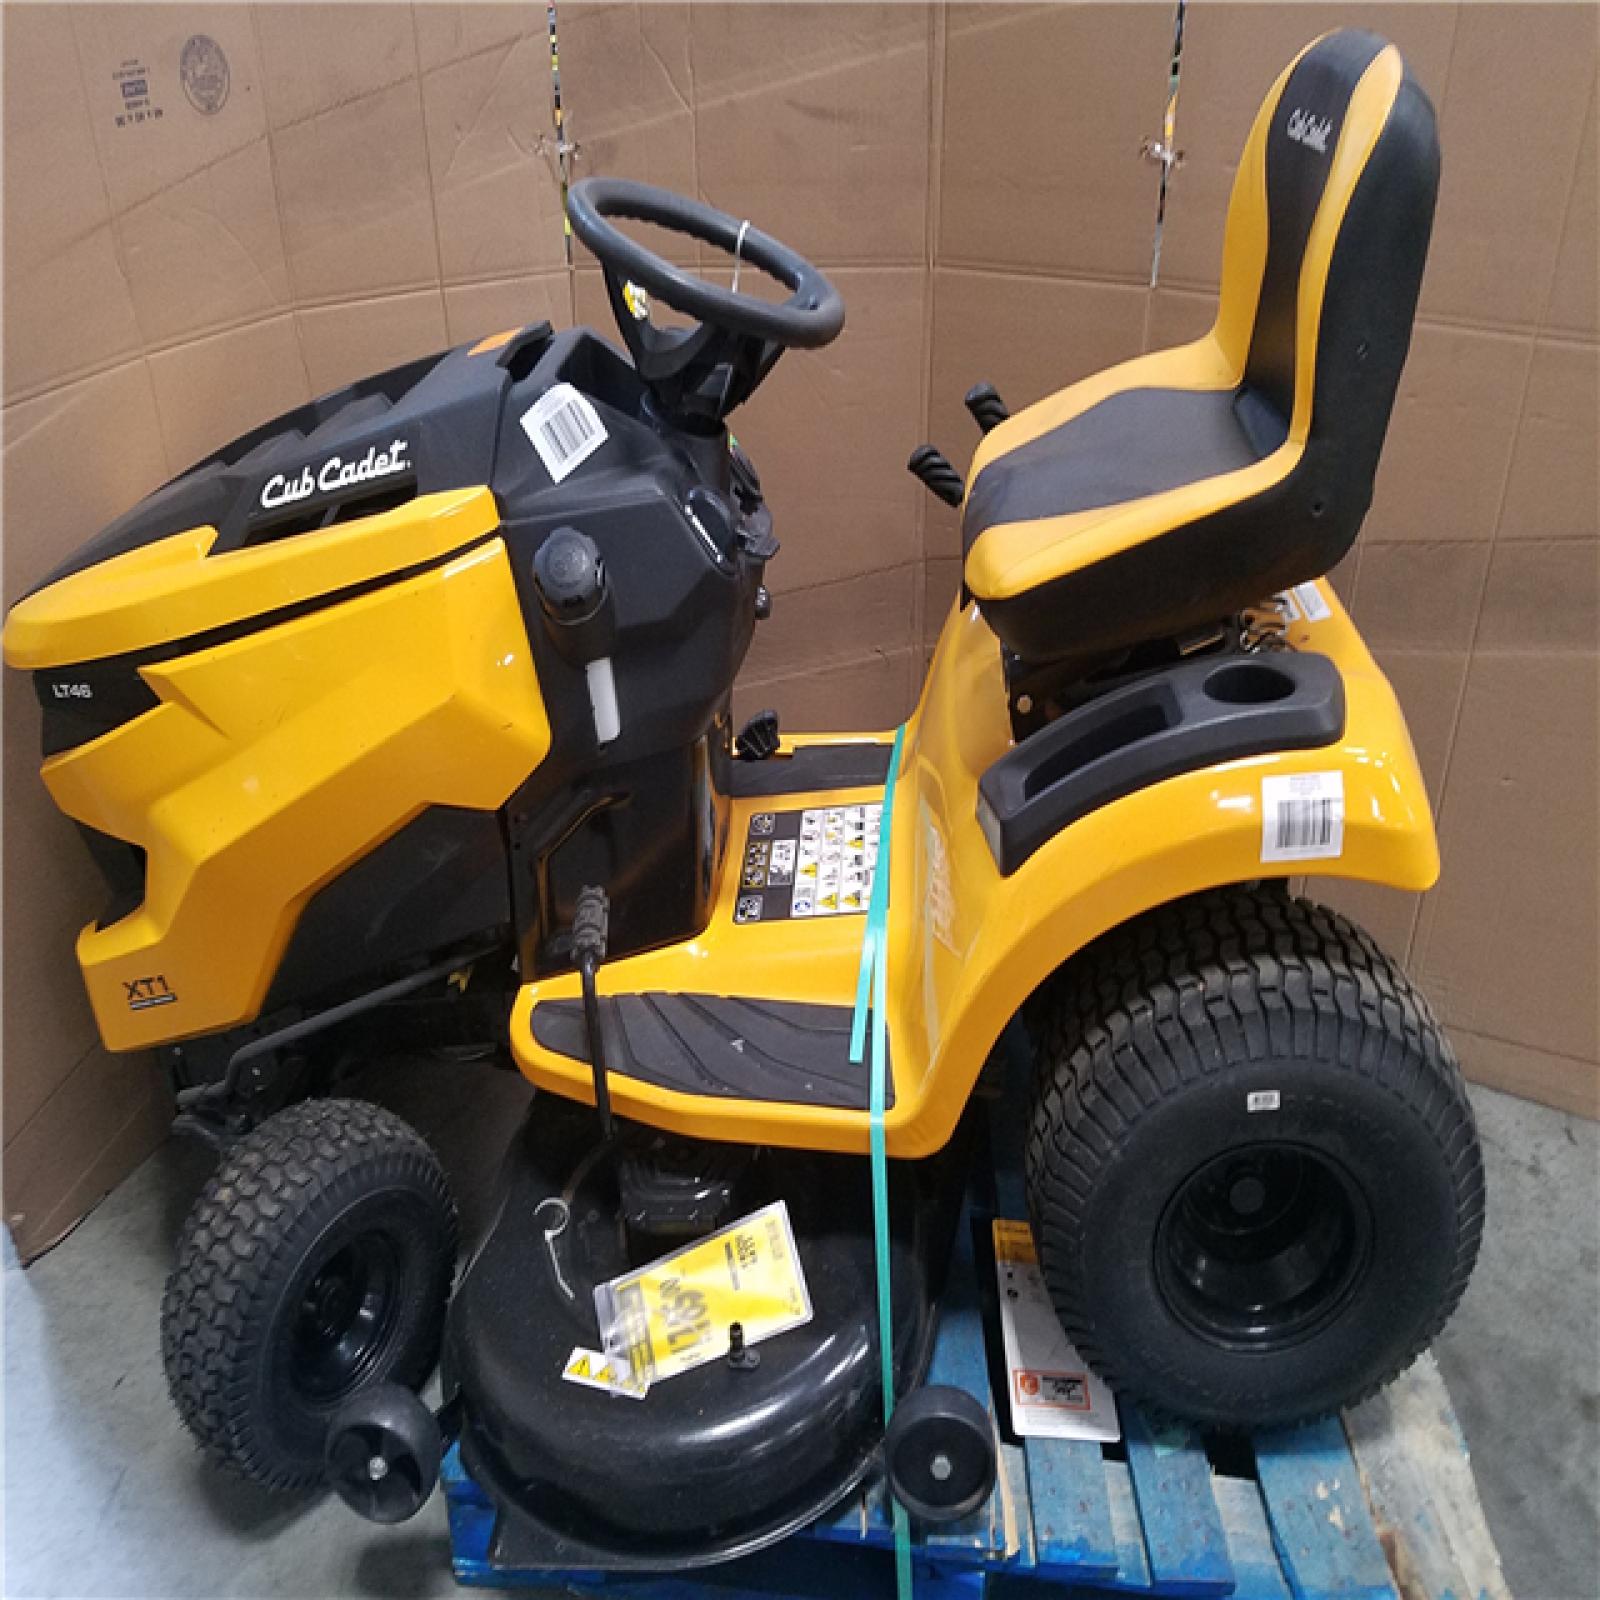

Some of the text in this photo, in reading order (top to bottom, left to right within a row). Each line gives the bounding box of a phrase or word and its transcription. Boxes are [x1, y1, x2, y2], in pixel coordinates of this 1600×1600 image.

[260, 439, 409, 508] Cub Cadet
[122, 974, 168, 1000] XT1
